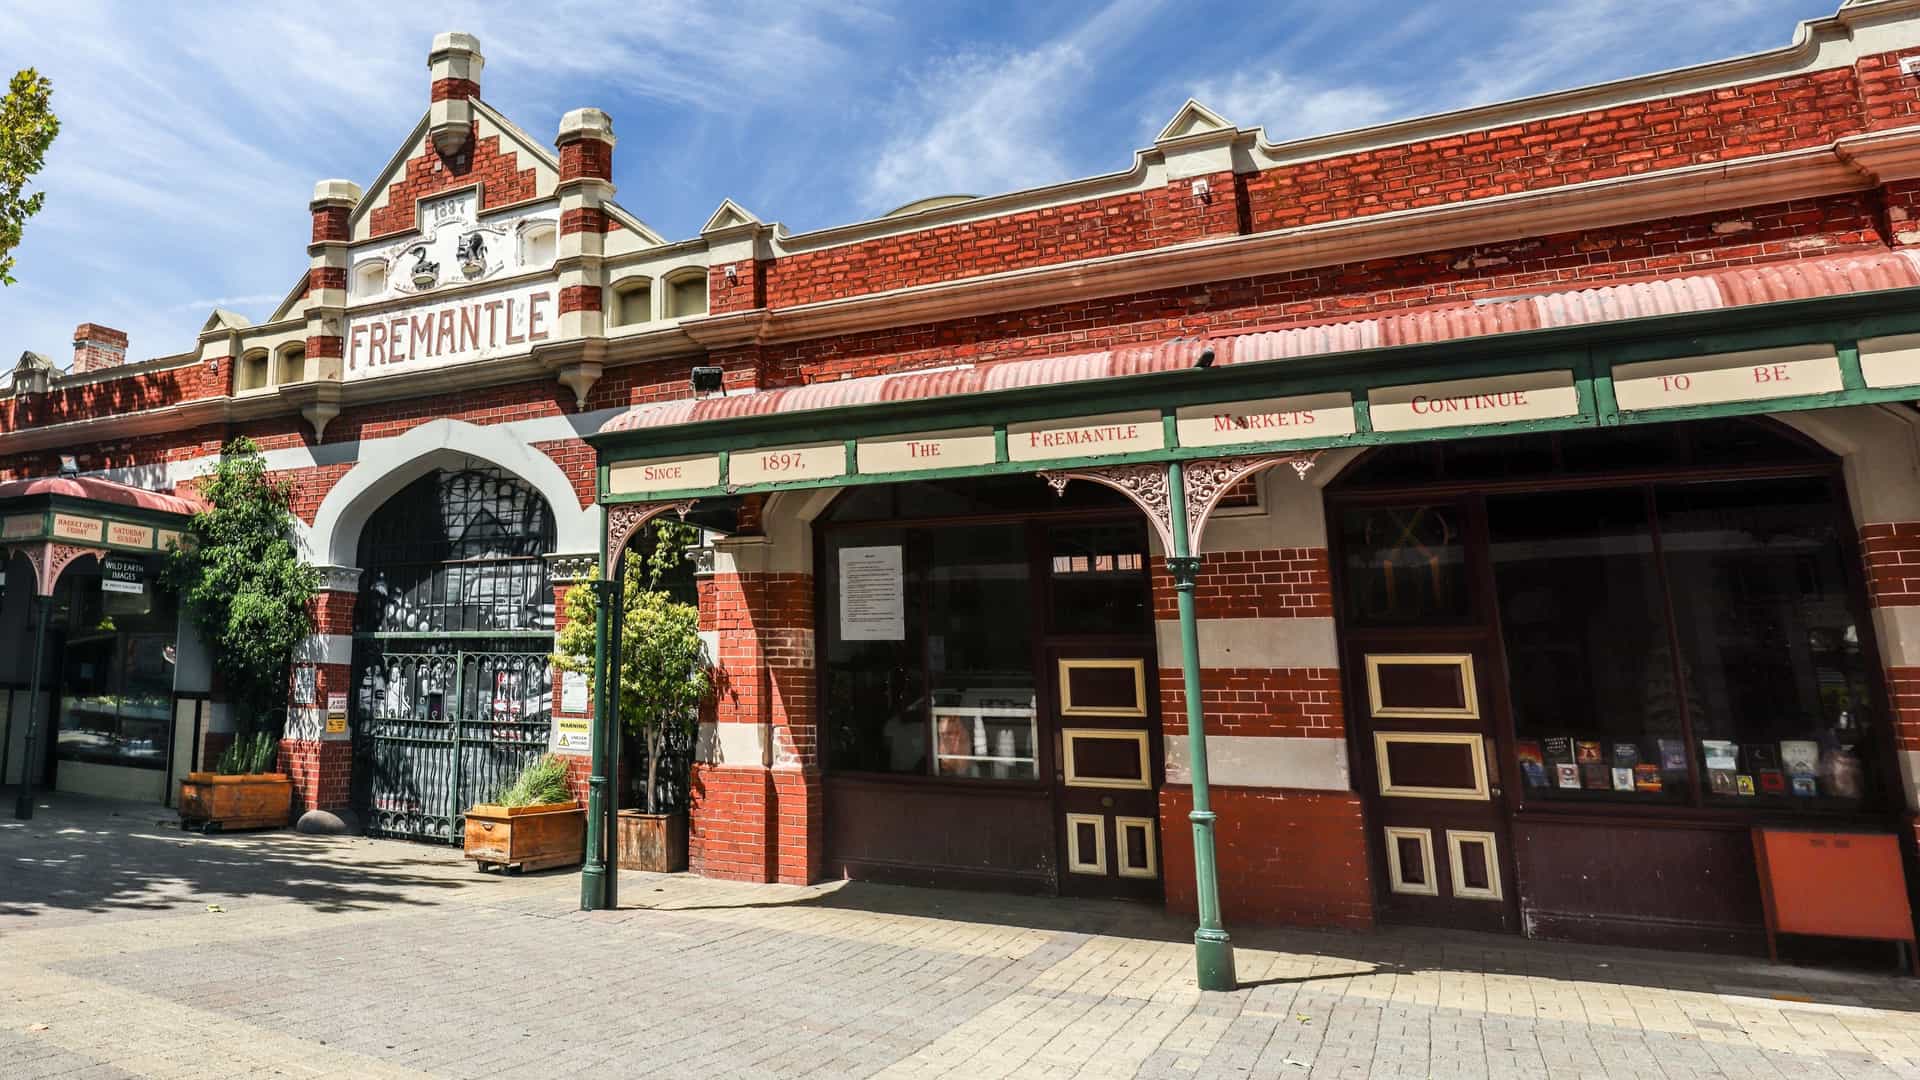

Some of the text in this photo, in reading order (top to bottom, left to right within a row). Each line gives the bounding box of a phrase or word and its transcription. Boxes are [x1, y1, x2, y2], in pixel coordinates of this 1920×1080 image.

[349, 291, 551, 370] FREMANTLE
[761, 453, 806, 472] 1897,
[1657, 374, 1692, 392] TO
[1751, 364, 1790, 384] BE
[113, 527, 146, 538] SATURDAY
[105, 560, 144, 572] WILD EARTH
[111, 571, 136, 580] IMAGES
[560, 722, 588, 730] WARNING
